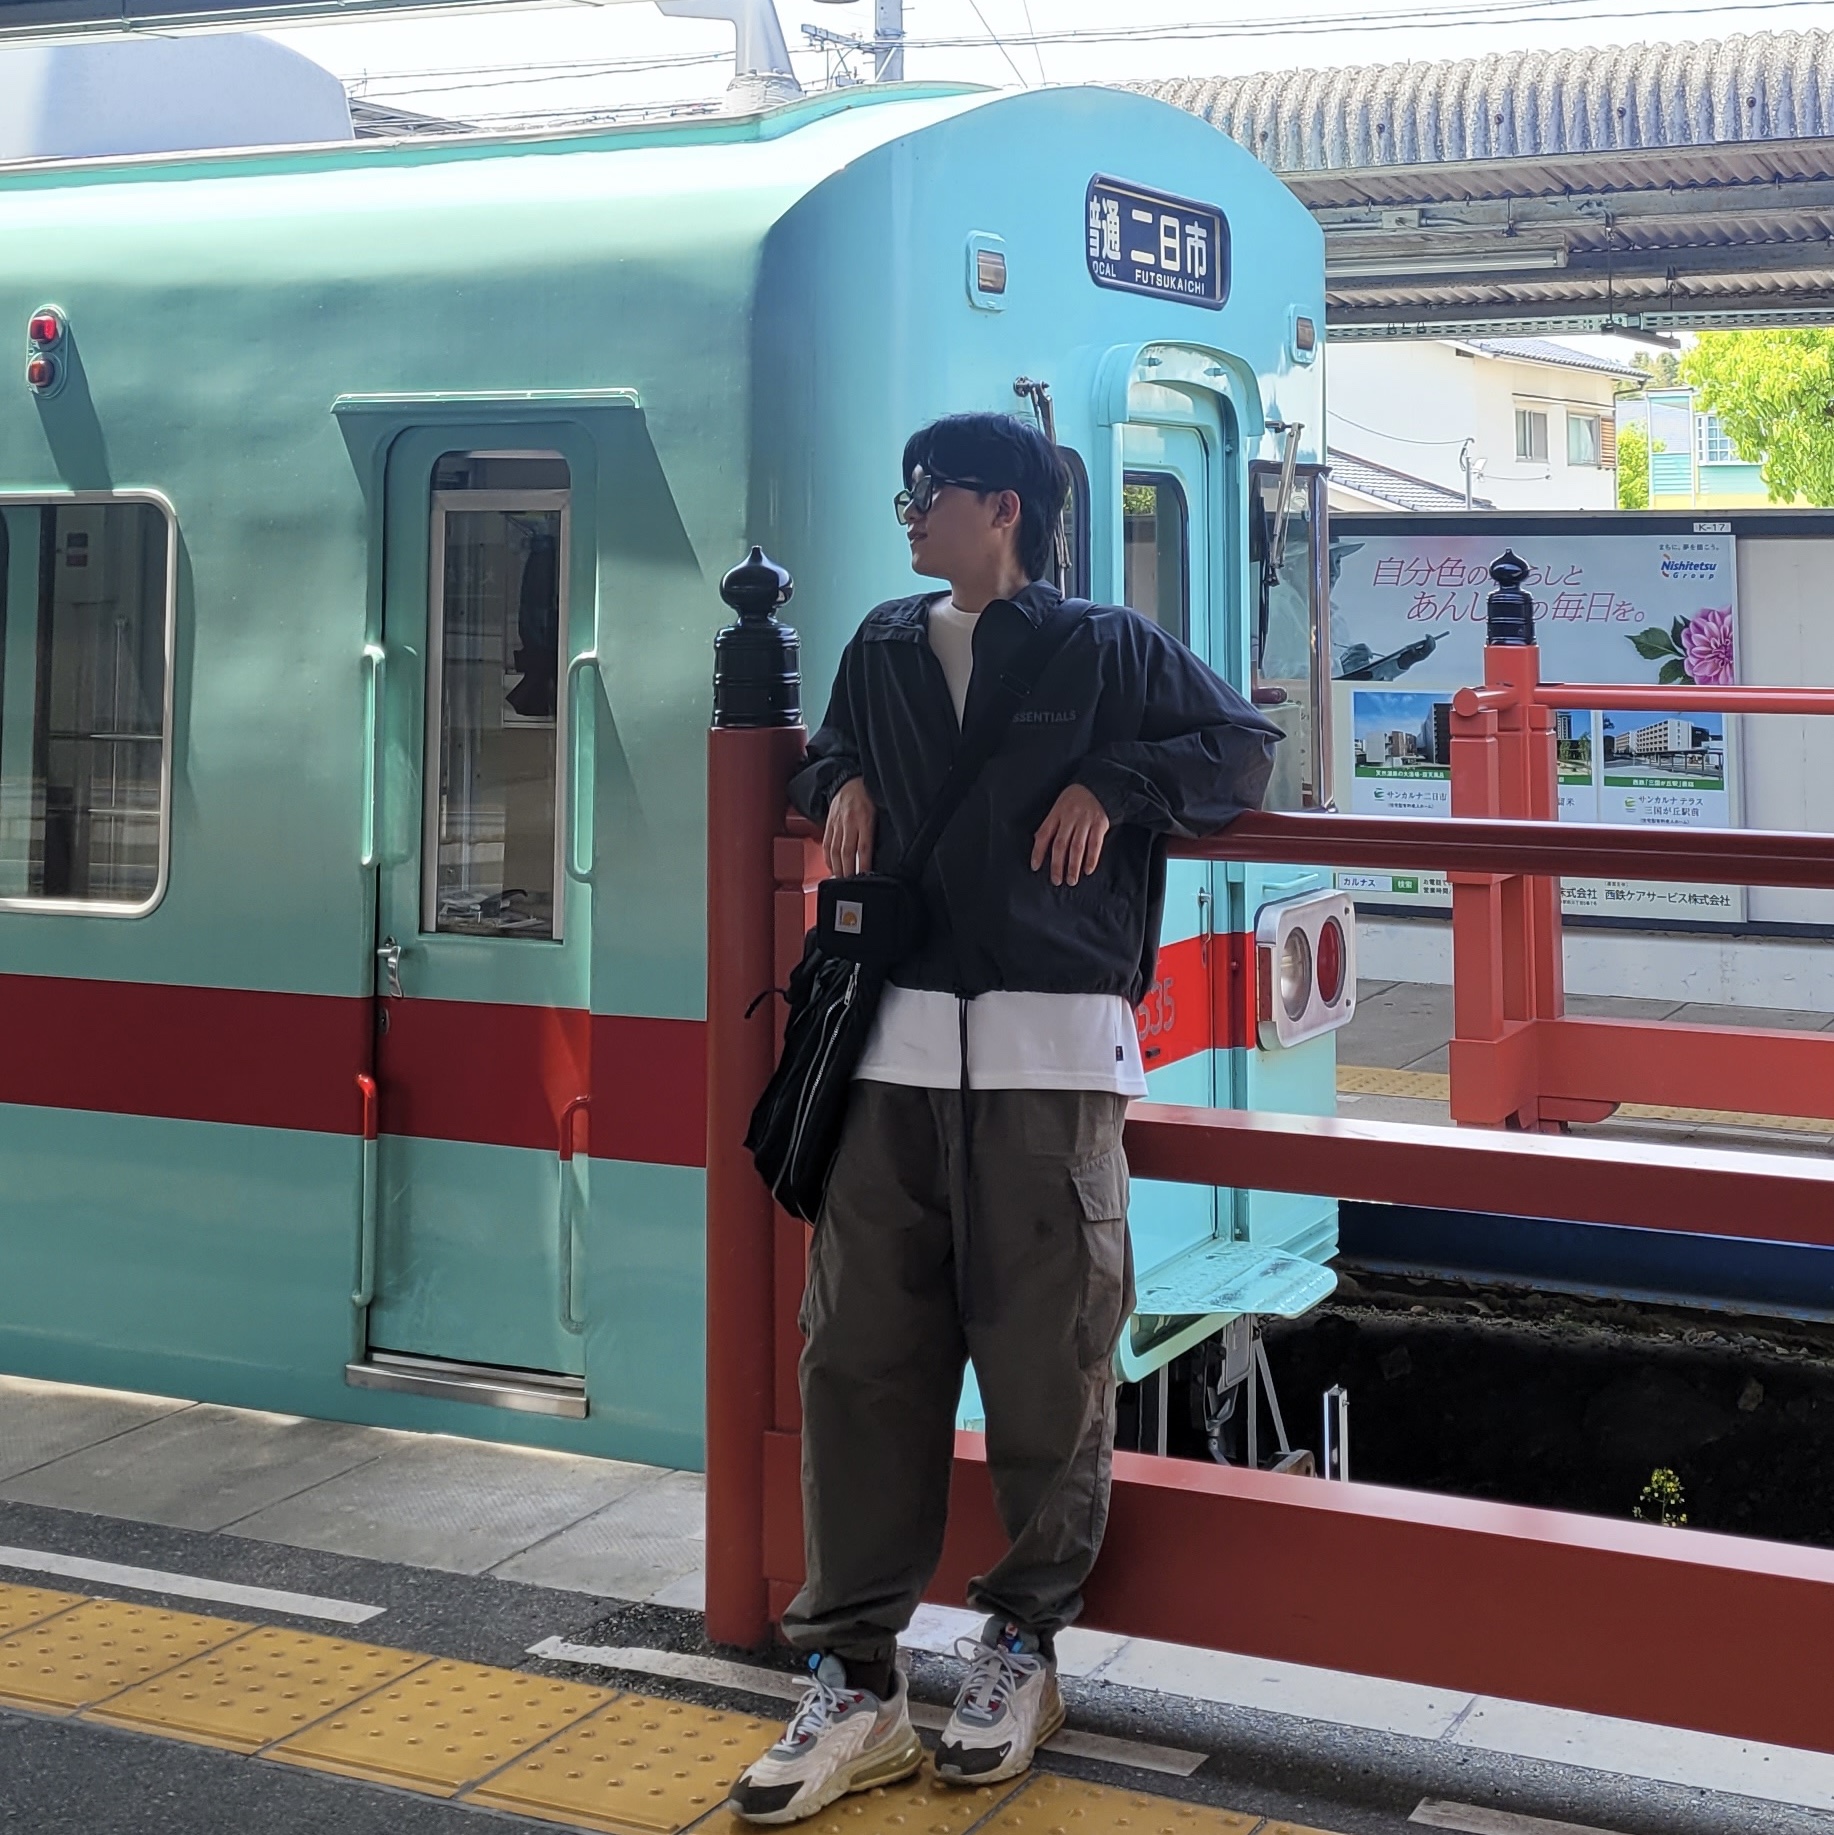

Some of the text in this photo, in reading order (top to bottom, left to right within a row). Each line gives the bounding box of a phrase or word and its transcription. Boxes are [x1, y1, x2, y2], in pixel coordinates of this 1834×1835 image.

[1130, 208, 1207, 278] 二日市
[1092, 260, 1205, 296] OCAL FUTSUKAICHI
[1698, 523, 1726, 532] K-17
[1661, 560, 1717, 571] Nishitetsu
[1373, 556, 1582, 587] 自分色のらしと
[1672, 572, 1714, 580] Group
[1407, 591, 1645, 622] あんしの毎日を。
[1012, 710, 1077, 722] SSENTIALS
[1639, 796, 1704, 806] サンカルナ テラス
[1644, 806, 1700, 817] 三国が丘駅前
[1343, 878, 1376, 888] カルナス
[1397, 880, 1413, 889] 検索
[1605, 889, 1732, 907] 西鉄ケアサービス株式会社
